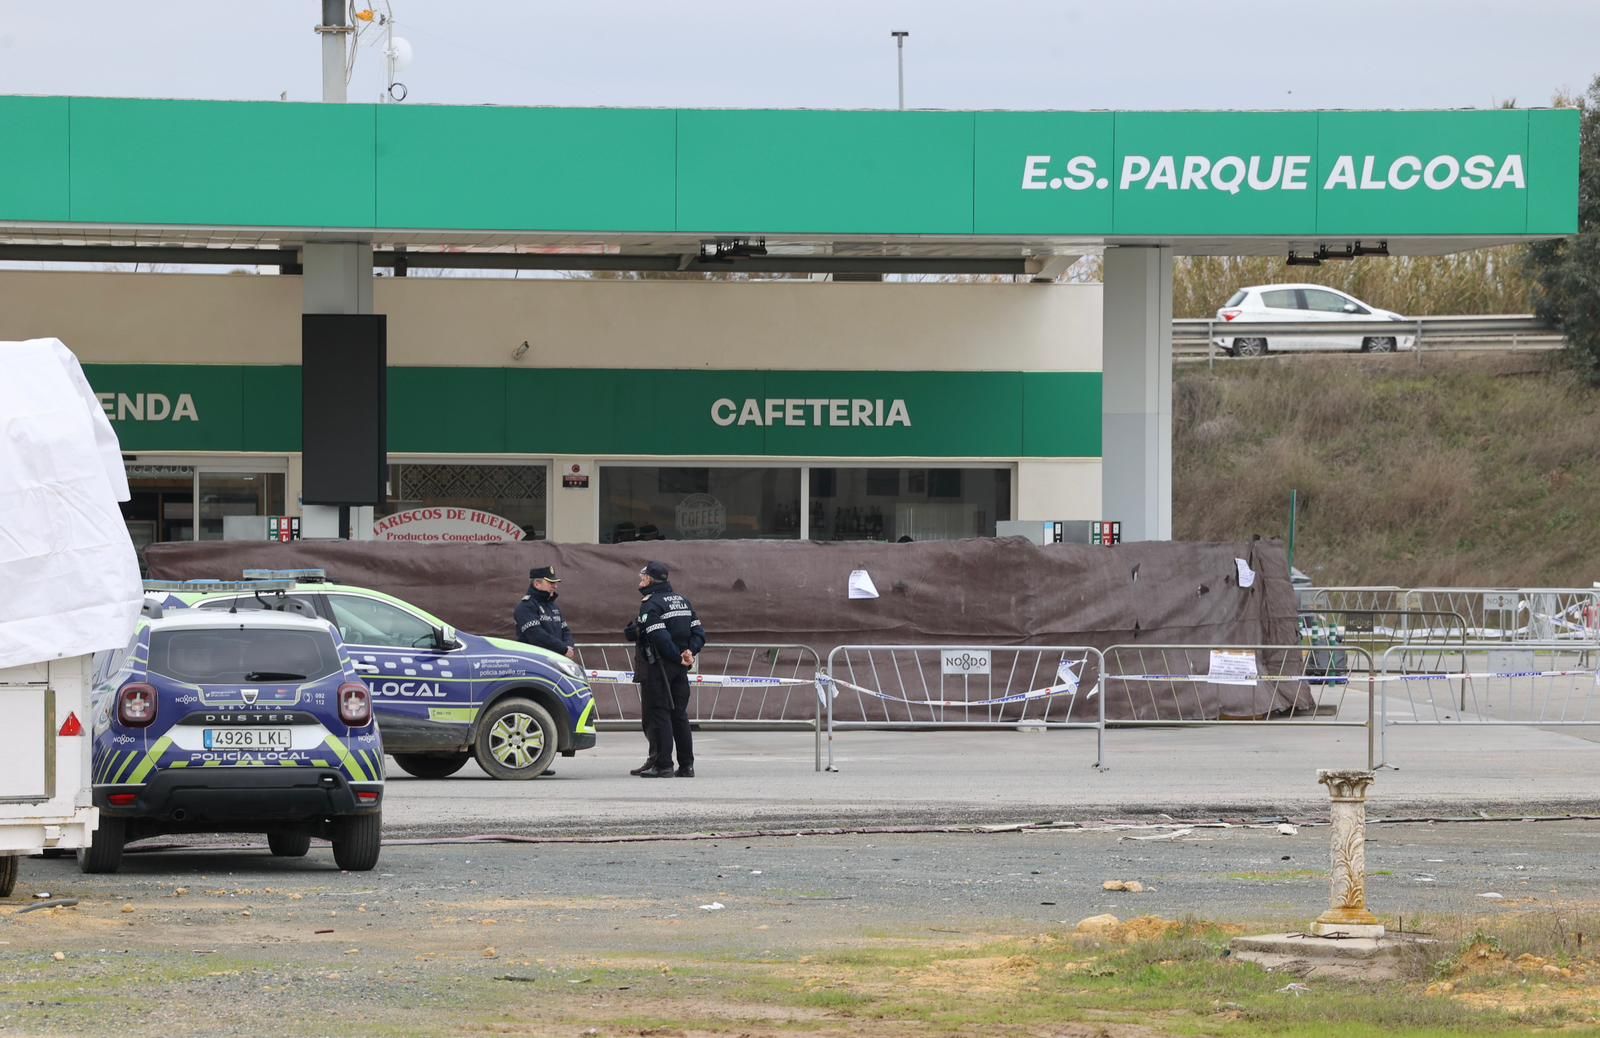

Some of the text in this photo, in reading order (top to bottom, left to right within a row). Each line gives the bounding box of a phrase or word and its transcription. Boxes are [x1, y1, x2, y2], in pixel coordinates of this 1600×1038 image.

[1022, 155, 1526, 195] E.S. PARQUE ALCOSA
[96, 392, 199, 422] ENDA
[710, 398, 912, 427] CAFETERIA
[447, 509, 466, 521] DE
[471, 511, 522, 541] HUELVA
[386, 532, 440, 542] Productos
[669, 603, 689, 611] SEVILLA
[369, 682, 447, 697] LOCAL
[215, 731, 287, 745] 4926 LKL
[191, 752, 310, 761] POLICÍA LOCAL
